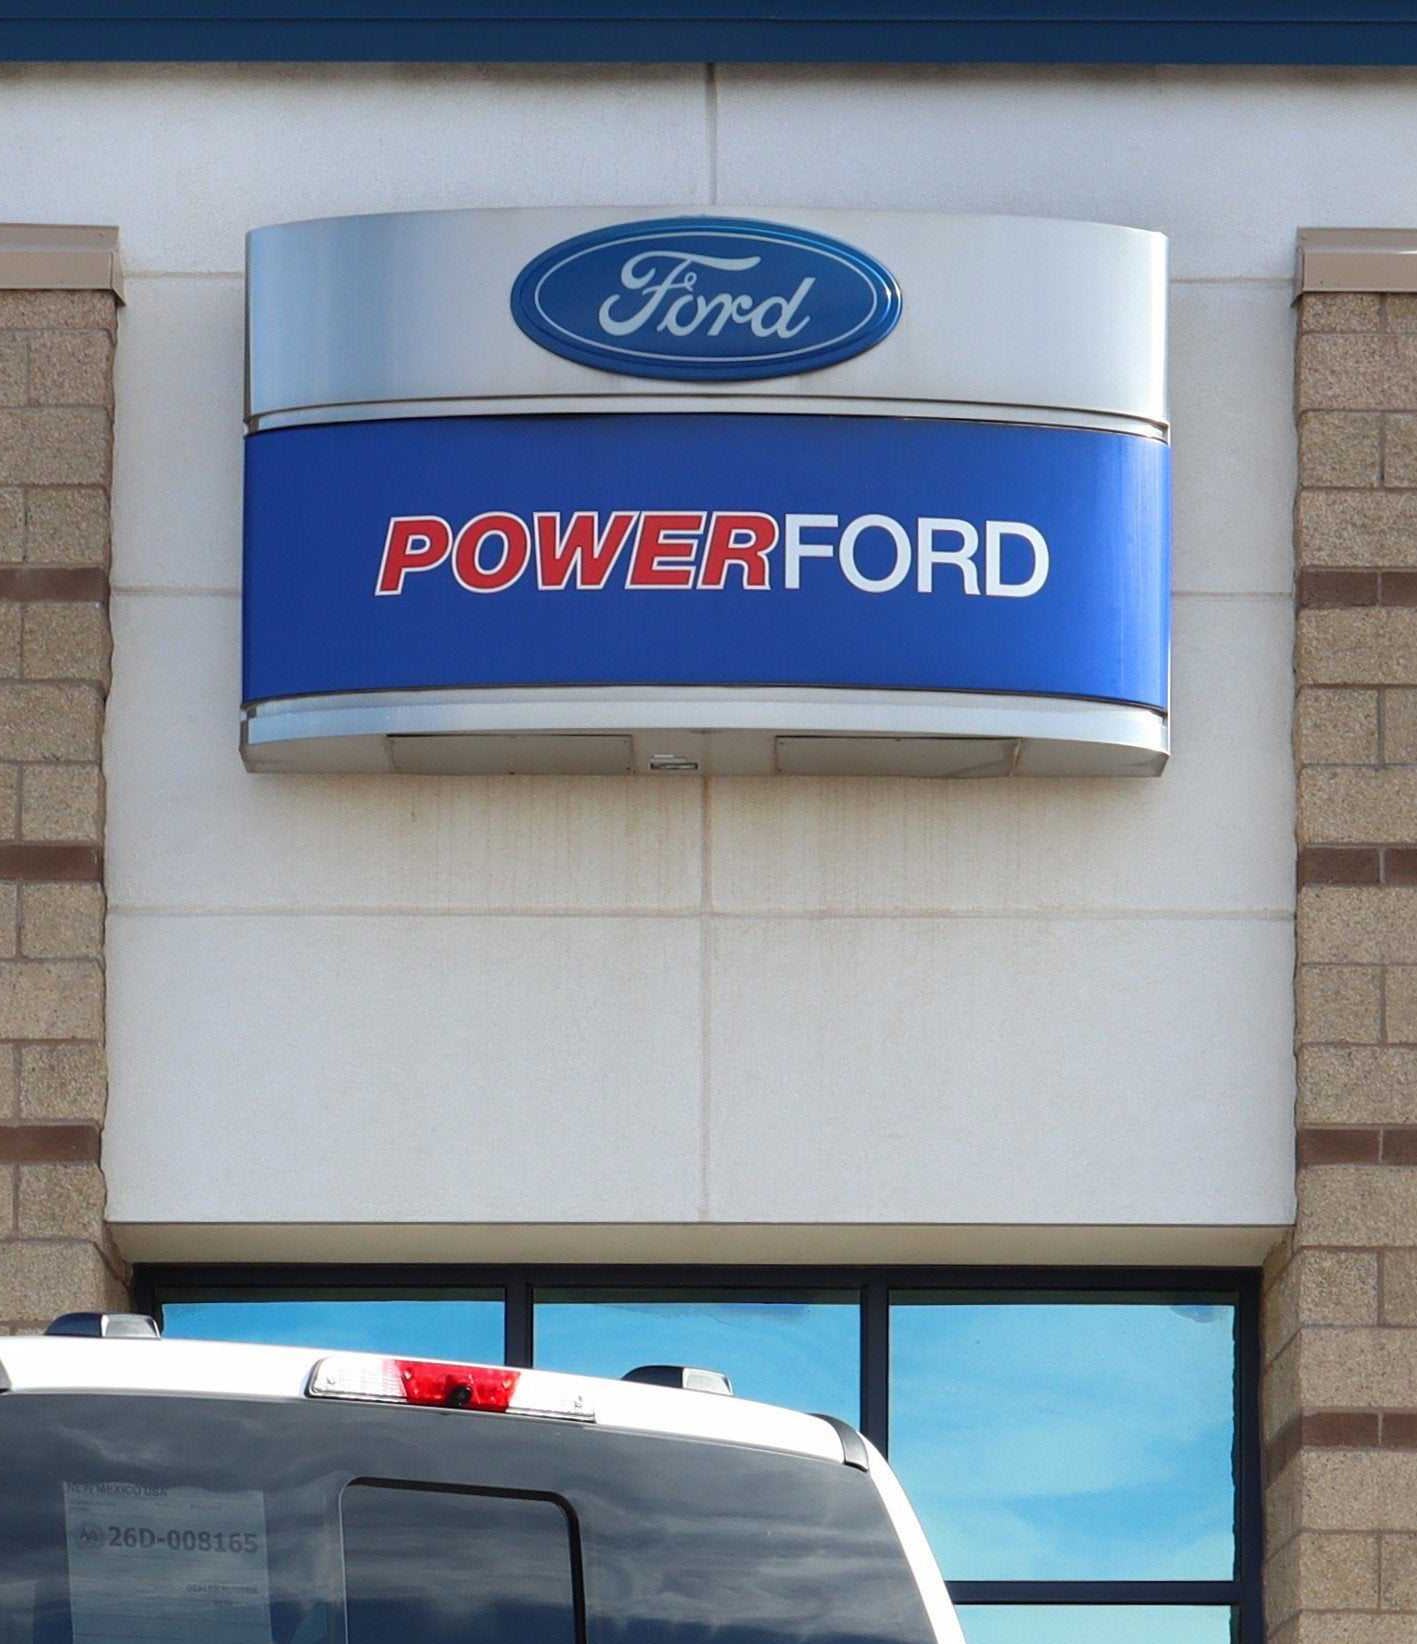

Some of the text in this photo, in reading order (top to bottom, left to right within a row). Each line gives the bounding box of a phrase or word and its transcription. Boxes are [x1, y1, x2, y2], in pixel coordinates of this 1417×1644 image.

[597, 249, 816, 339] Ford
[375, 510, 1050, 597] POWERFORD
[96, 1484, 142, 1497] MEXICO
[144, 1485, 168, 1497] USA
[108, 1525, 259, 1554] 26D-008165
